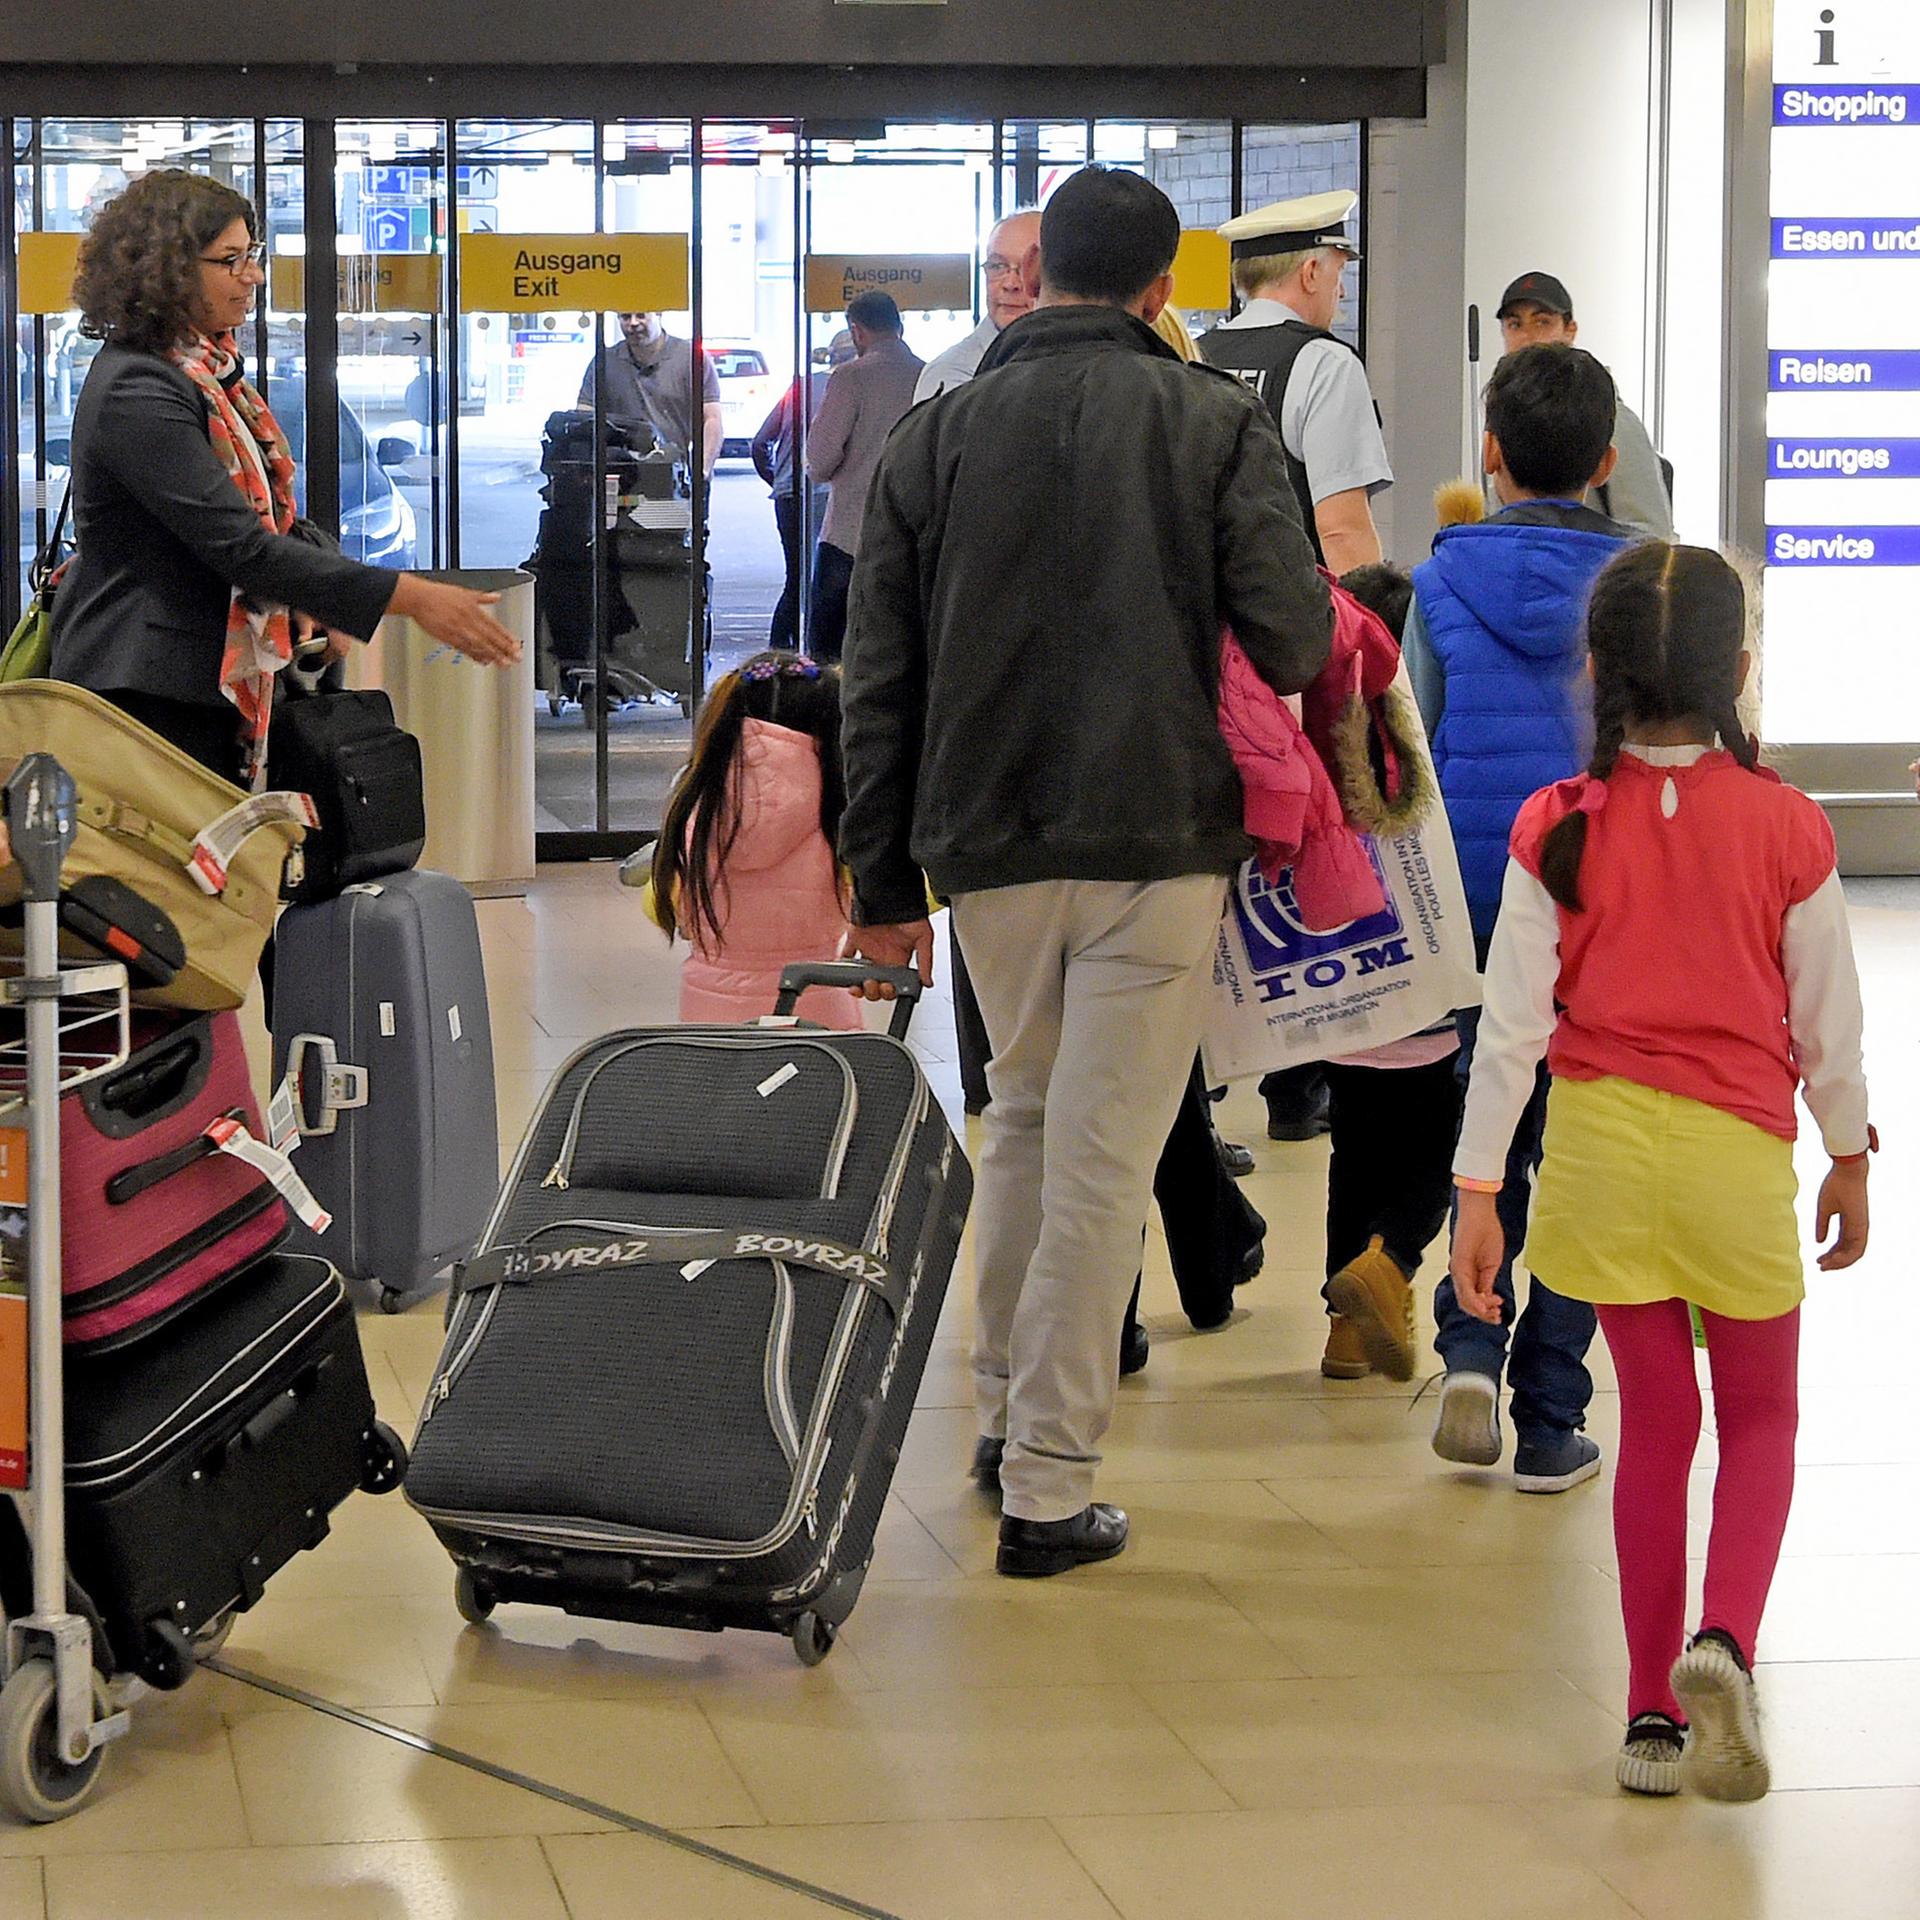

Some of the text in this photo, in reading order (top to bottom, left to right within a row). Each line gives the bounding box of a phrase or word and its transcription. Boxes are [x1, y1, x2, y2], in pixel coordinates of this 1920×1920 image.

[1782, 90, 1907, 121] Shopping
[1782, 224, 1920, 251] Essen und
[514, 250, 621, 274] Ausgang
[843, 266, 922, 284] Ausgang
[514, 277, 560, 297] Exit
[1779, 358, 1871, 383] Reisen
[1776, 444, 1890, 475] Lounges
[1774, 533, 1875, 559] Service
[1415, 857, 1431, 881] LES
[1401, 859, 1440, 954] ORGANISATION
[1424, 882, 1444, 920] POUR
[1254, 937, 1414, 1003] IOM
[1266, 979, 1411, 1026] INTERNATIONAL ORGANIZATION
[1305, 1001, 1380, 1028] FOR MIGRATION
[734, 1234, 888, 1287] BOYRAZ
